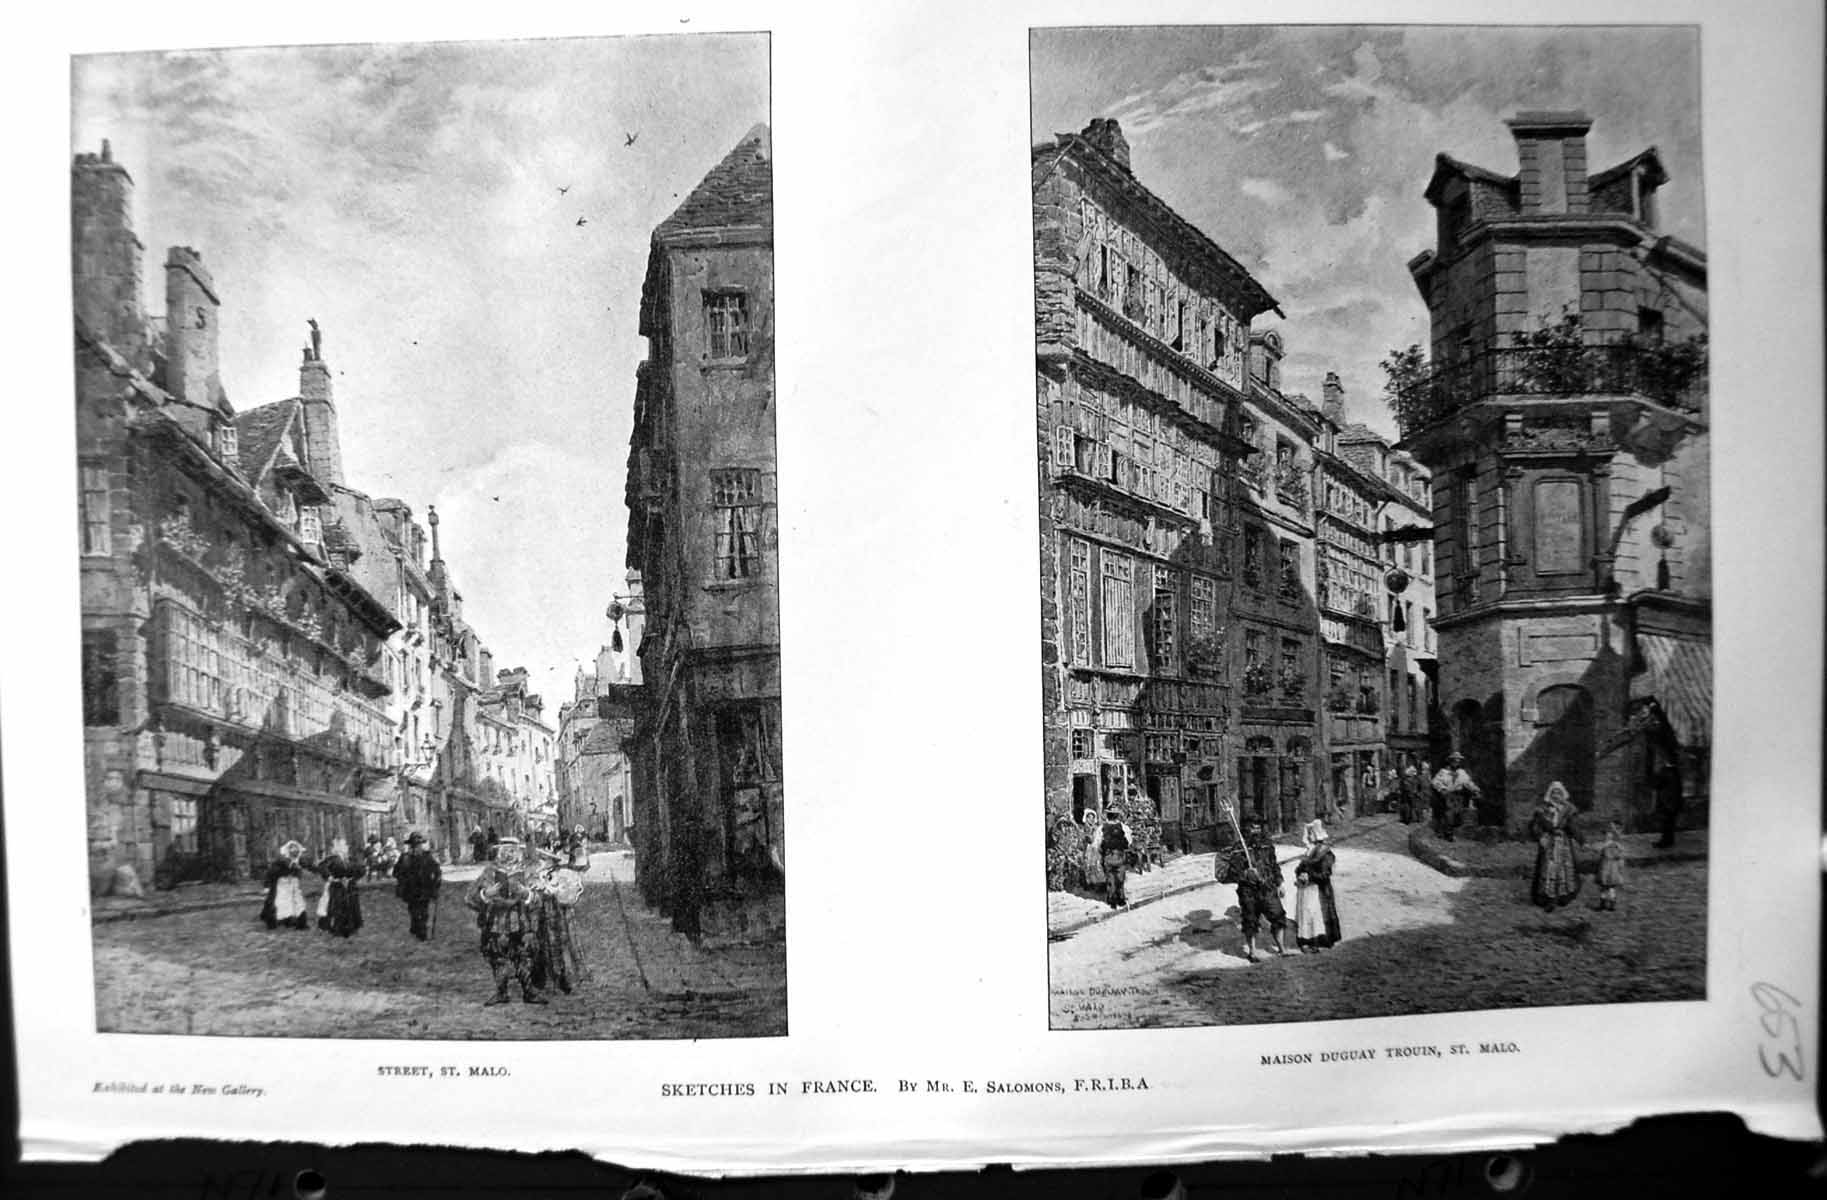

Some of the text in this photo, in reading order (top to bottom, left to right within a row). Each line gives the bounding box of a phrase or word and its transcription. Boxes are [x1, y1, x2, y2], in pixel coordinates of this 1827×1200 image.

[1260, 1042, 1521, 1065] MAISON DUGUAY TROUIN, ST. MALO.
[376, 1065, 512, 1079] STREET, ST. MALO.
[152, 1083, 164, 1094] at
[169, 1083, 187, 1095] the
[191, 1083, 217, 1096] New
[222, 1083, 266, 1098] Gallery.
[661, 1083, 756, 1096] SKETCHES
[768, 1082, 788, 1095] IN
[802, 1080, 878, 1094] FRANCE.
[962, 1080, 978, 1093] E.
